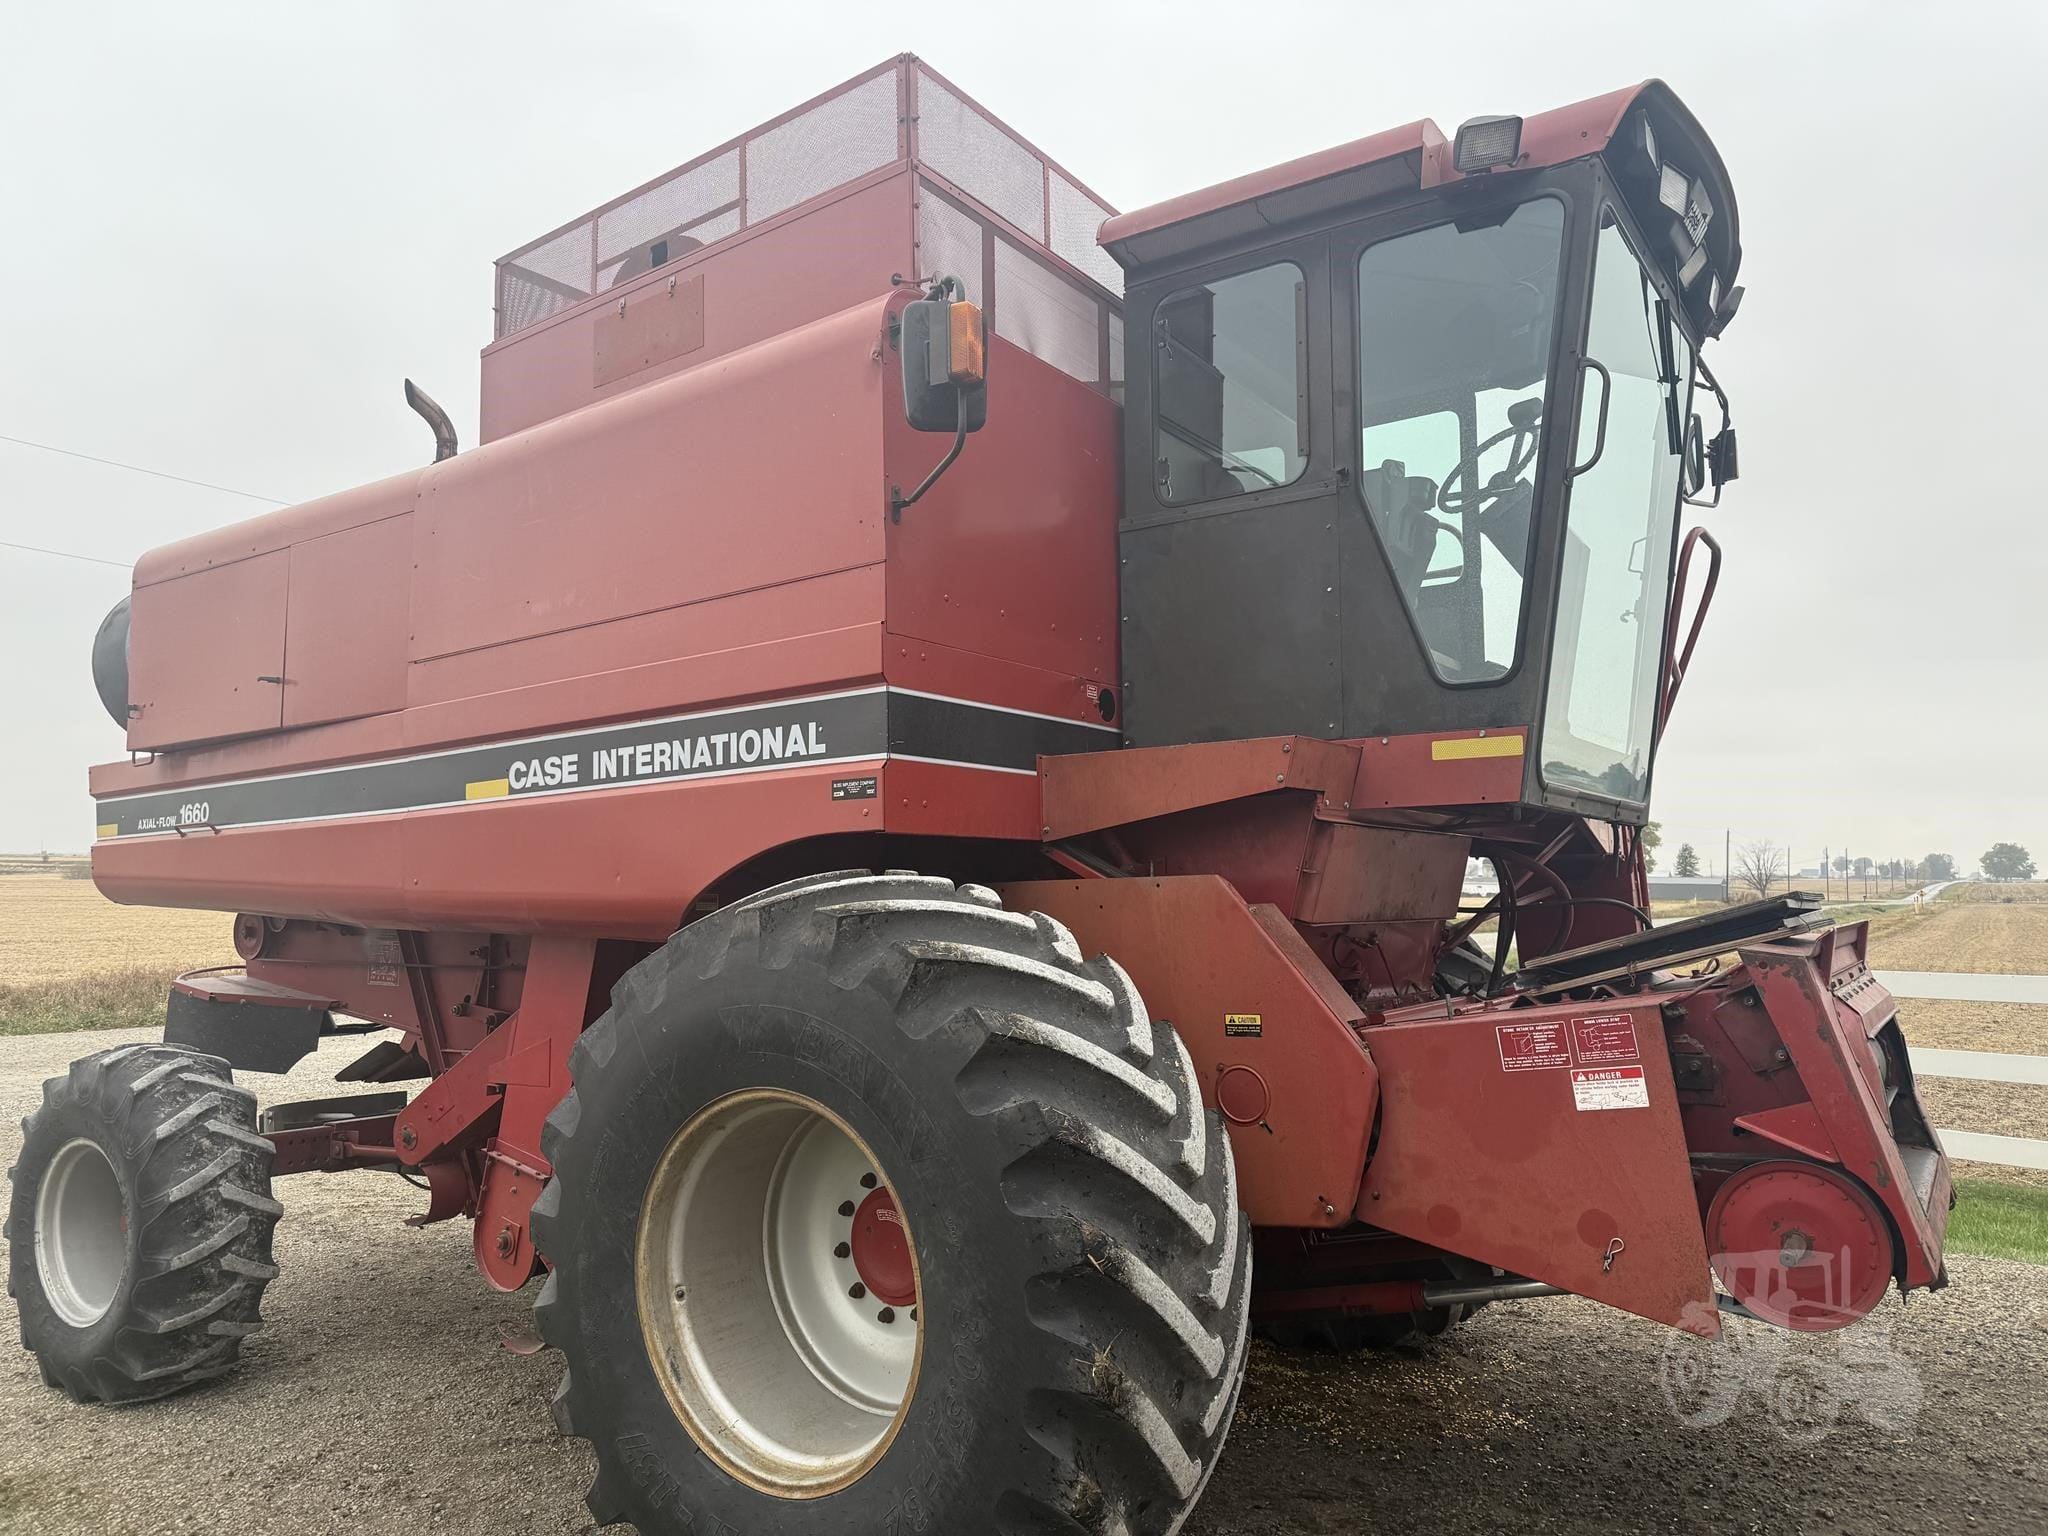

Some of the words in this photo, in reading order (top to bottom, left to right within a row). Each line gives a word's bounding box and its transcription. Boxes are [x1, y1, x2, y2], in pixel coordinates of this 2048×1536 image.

[508, 753, 579, 790] CASE
[592, 721, 826, 781] INTERNATIONAL
[180, 801, 210, 824] 1660
[1237, 1016, 1257, 1024] CAUTION
[1588, 1071, 1622, 1081] DANGER
